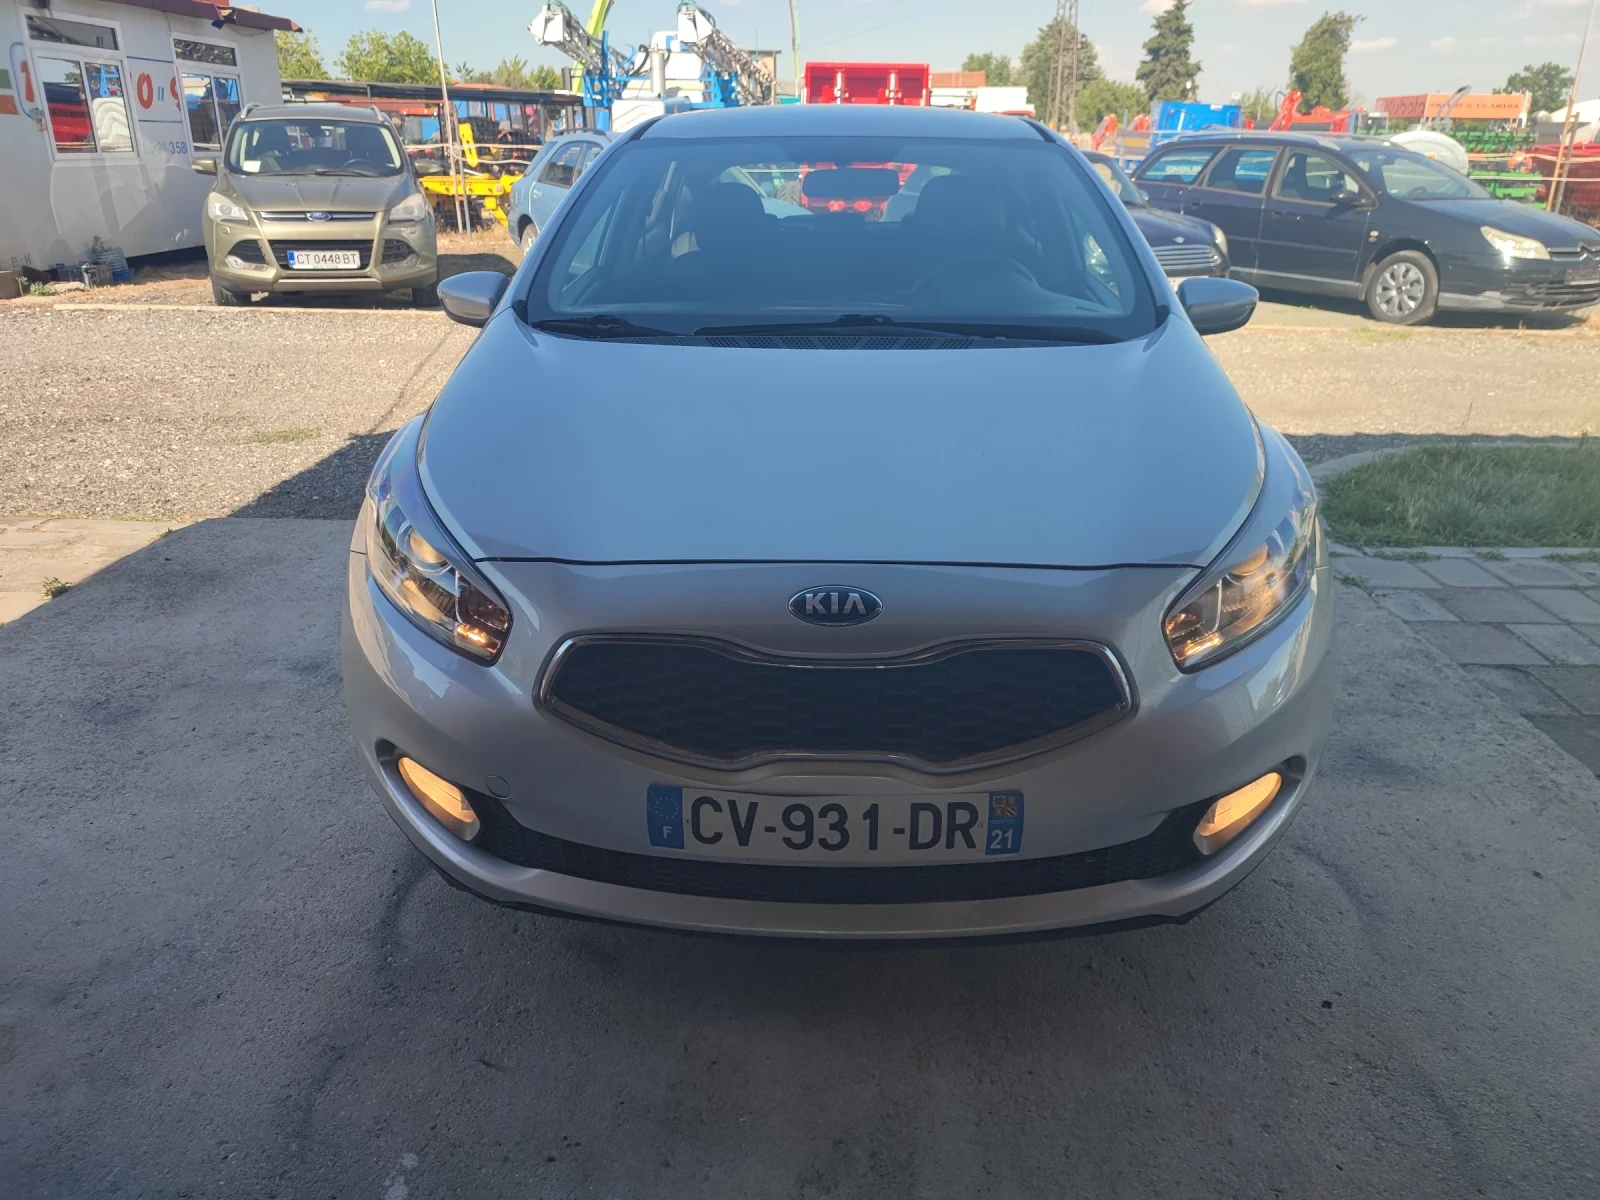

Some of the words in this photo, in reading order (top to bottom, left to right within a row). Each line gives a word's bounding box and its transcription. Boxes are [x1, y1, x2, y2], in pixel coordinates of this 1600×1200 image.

[296, 253, 311, 265] CT
[313, 253, 341, 265] 0448
[342, 253, 357, 265] BT
[805, 592, 867, 615] KIA
[662, 825, 673, 839] F
[691, 796, 979, 851] CV-931-DR
[989, 828, 1014, 849] 21
